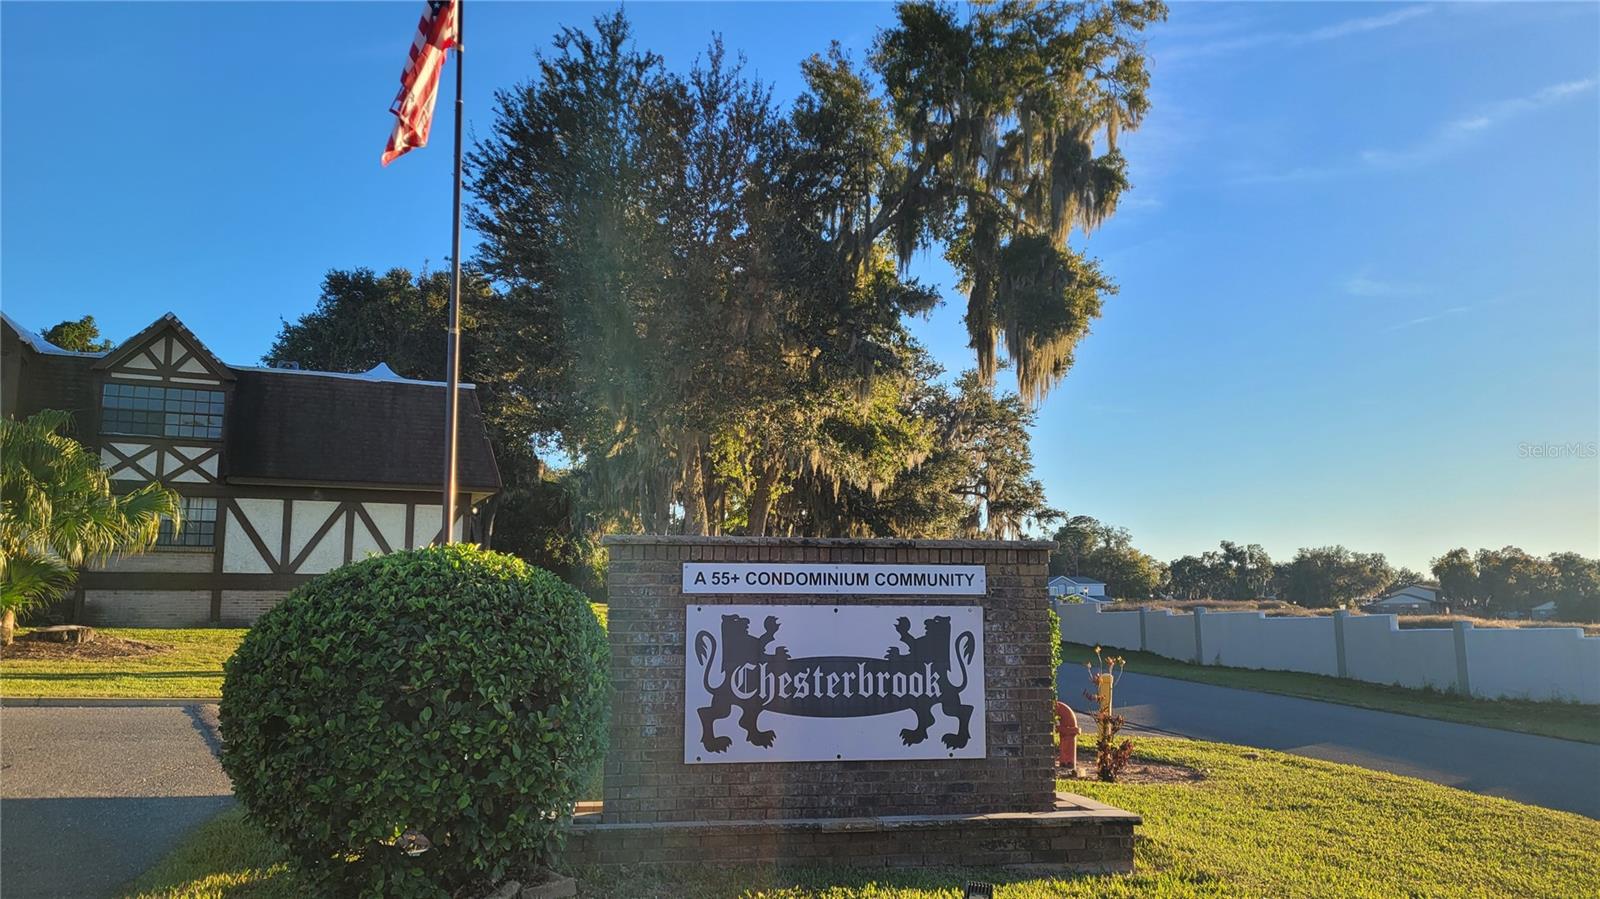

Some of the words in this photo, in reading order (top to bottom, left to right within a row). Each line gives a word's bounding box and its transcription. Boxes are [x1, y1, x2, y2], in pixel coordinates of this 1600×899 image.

[694, 571, 706, 585] A
[711, 571, 740, 586] 55+
[745, 572, 869, 587] CONDOMINIUM
[875, 572, 976, 587] COMMUNITY
[730, 662, 943, 706] Chesterbrook
